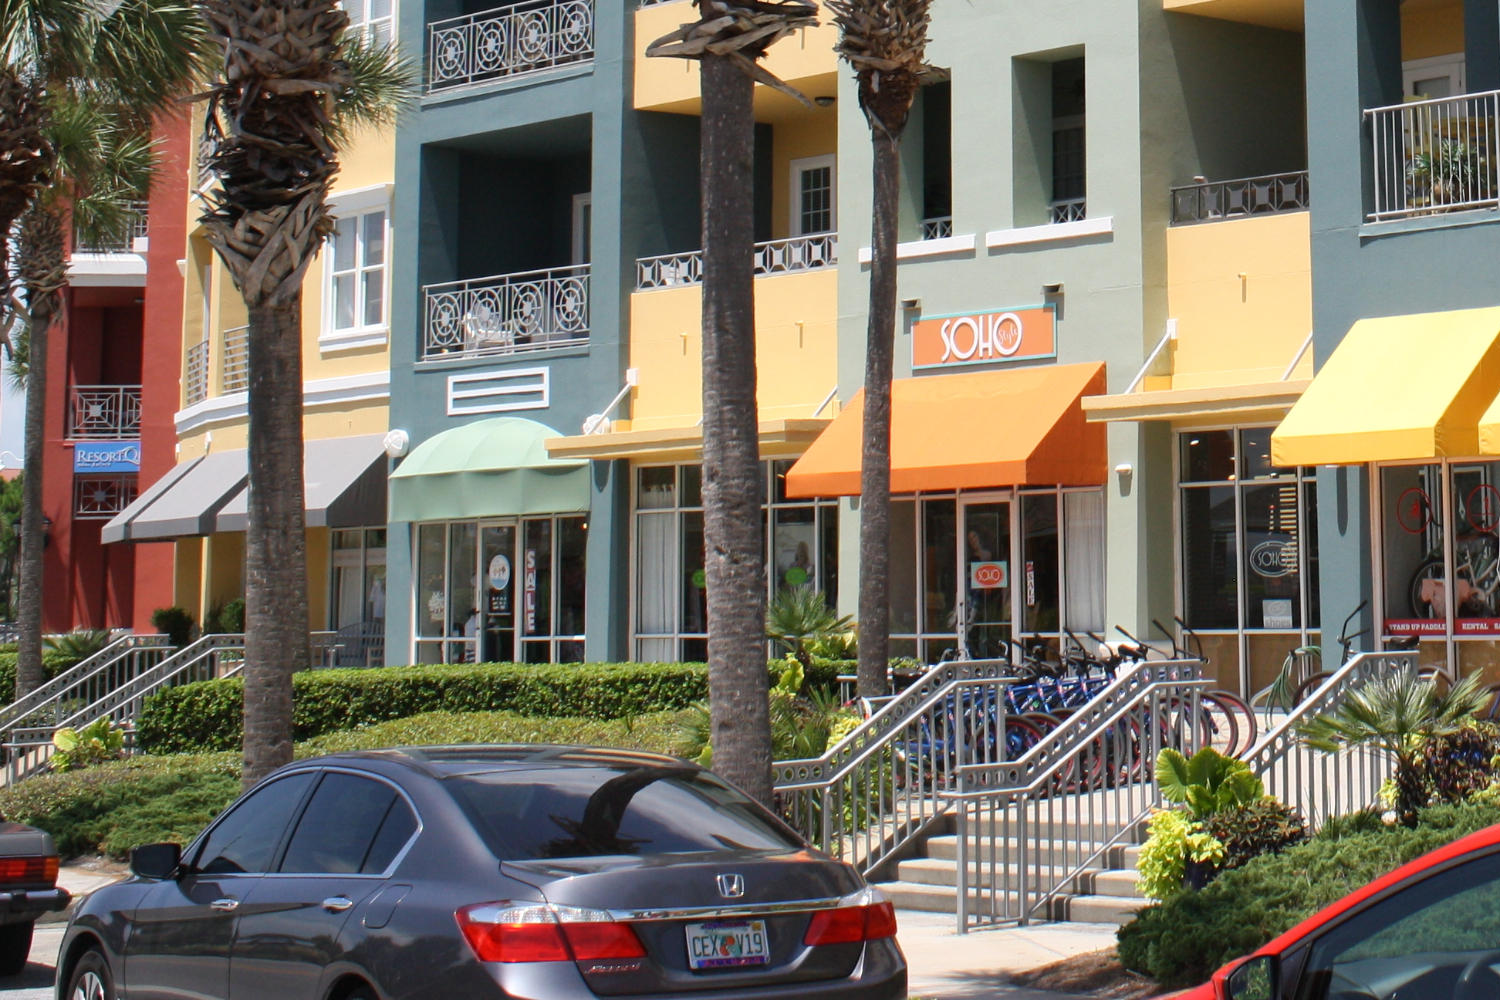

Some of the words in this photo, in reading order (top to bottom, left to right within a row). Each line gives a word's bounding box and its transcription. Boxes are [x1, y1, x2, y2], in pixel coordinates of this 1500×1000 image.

[940, 312, 1023, 362] SOHO
[527, 550, 536, 631] SALE
[1462, 622, 1488, 630] RENTAL
